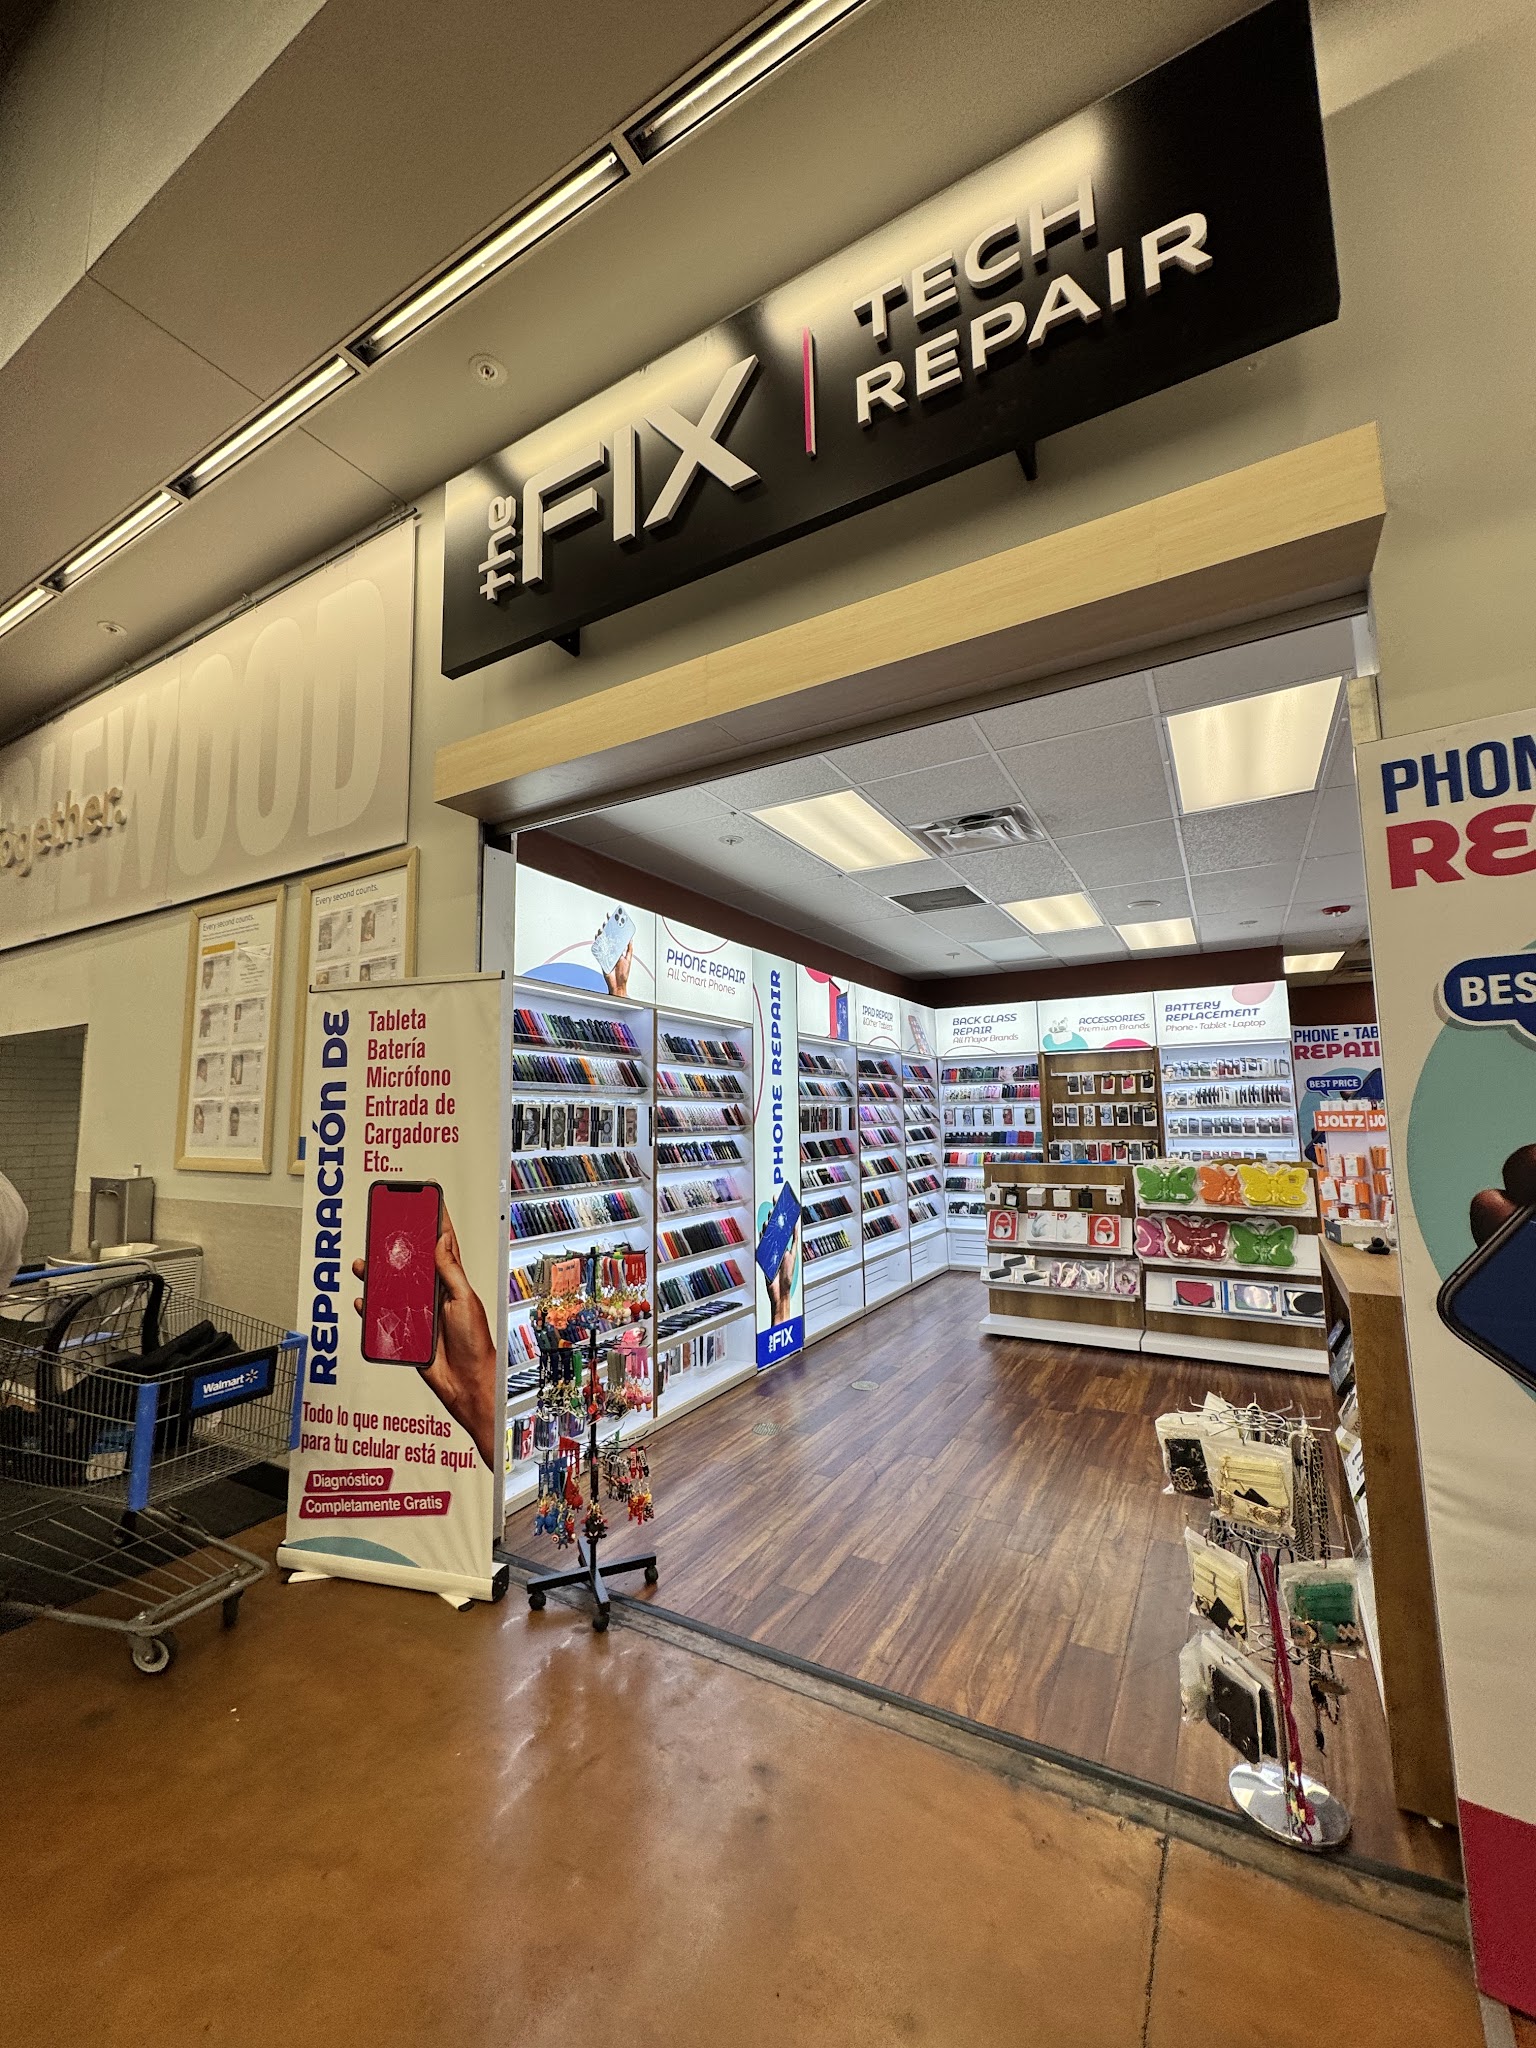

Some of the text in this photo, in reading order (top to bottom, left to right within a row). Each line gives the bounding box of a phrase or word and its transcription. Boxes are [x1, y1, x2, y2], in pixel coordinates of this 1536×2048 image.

[852, 174, 1097, 343] TECH
[856, 212, 1214, 427] REPAIR
[478, 354, 762, 601] the FIX
[0, 786, 128, 878] ogether.
[667, 948, 747, 985] PHONE REPAIR
[667, 967, 736, 995] All Smart Phones
[1165, 1000, 1221, 1012] BATTERY
[1165, 1008, 1260, 1022] REPLACEMENT
[368, 1008, 427, 1032] Tableta
[953, 1013, 1018, 1026] BACK GLASS
[1078, 1021, 1150, 1032] Premium Brands
[1079, 1013, 1145, 1025] ACCESSORIES
[1165, 1020, 1266, 1032] Phone Tablet Laptop
[322, 1009, 350, 1068] DE
[953, 1026, 992, 1036] REPAIR
[964, 1035, 989, 1044] Major
[990, 1033, 1018, 1042] Brands
[1294, 1028, 1339, 1043] PHONE
[367, 1037, 426, 1060] Batería
[366, 1065, 451, 1088] Micrófono
[770, 969, 784, 1185] PHONE REPAIR
[1309, 1079, 1359, 1089] BEST PRICE
[365, 1092, 456, 1117] Entrada de
[1317, 1114, 1365, 1128] iJOLTZ
[364, 1121, 459, 1149] Cargadores
[364, 1150, 403, 1172] Etc...
[773, 1325, 793, 1351] FIX
[203, 1374, 245, 1394] Walmart
[303, 1401, 451, 1438] Todo lo que necesitas
[301, 1433, 477, 1472] para tu celular está aquí.
[312, 1472, 384, 1490] Diagnóstico
[305, 1495, 443, 1516] Completamente Gratis
